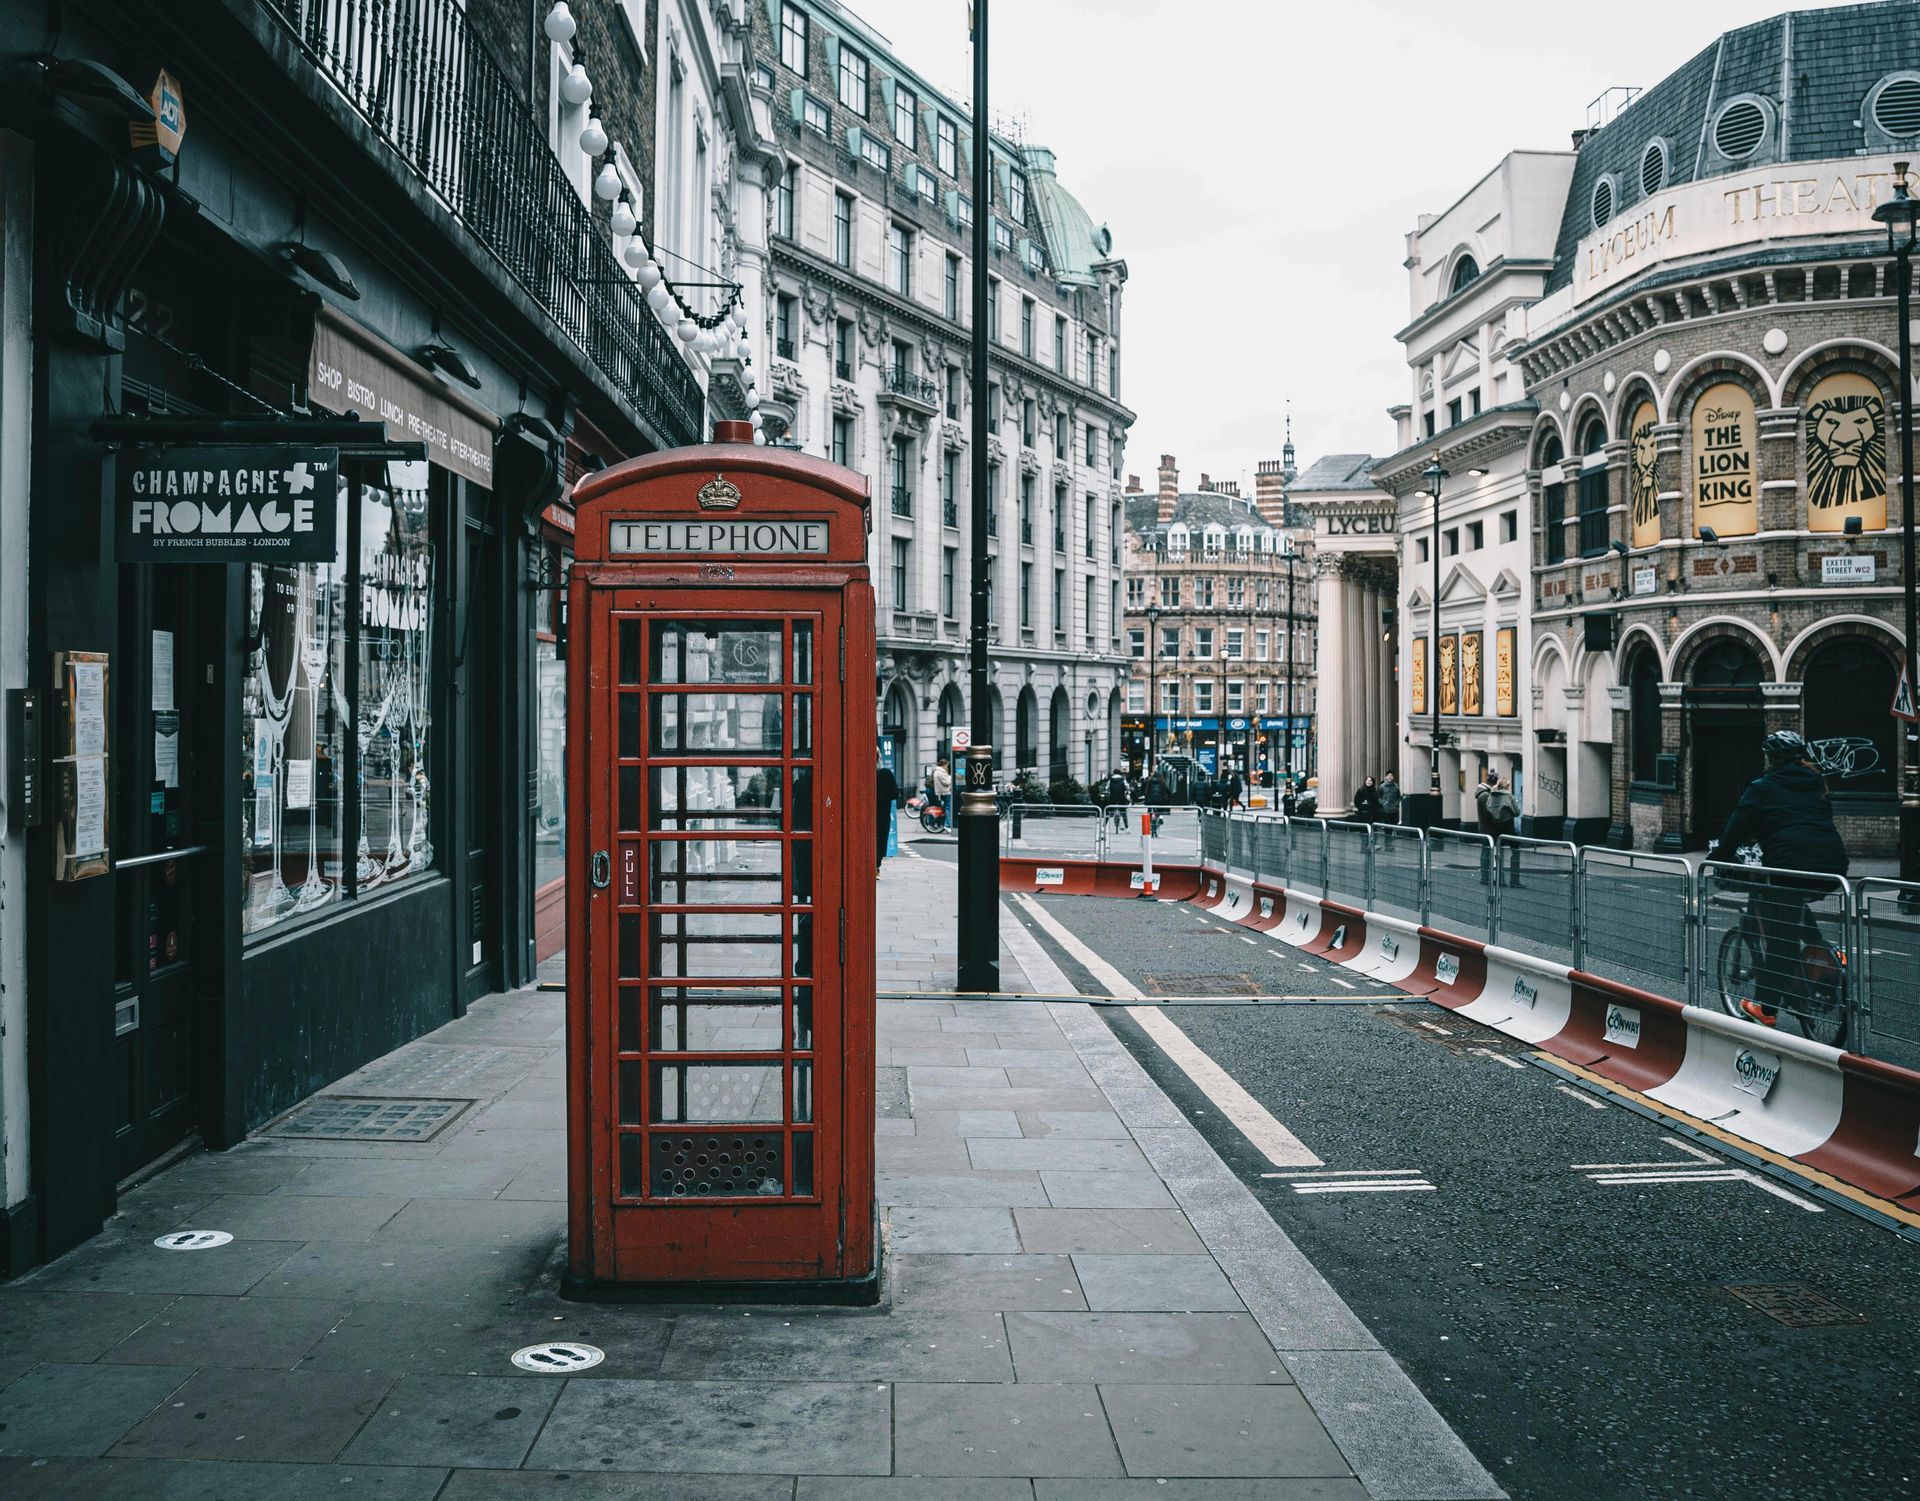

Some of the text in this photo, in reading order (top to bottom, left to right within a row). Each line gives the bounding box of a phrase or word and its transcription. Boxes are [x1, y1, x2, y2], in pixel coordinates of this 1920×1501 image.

[161, 101, 179, 127] ADT
[1589, 203, 1677, 281] LYCEUM
[318, 361, 491, 472] SHOP BISTRO LUNCH PRE-THEATRE AFTER-THEATRE
[1704, 424, 1742, 446] THE
[1699, 452, 1750, 475] LION
[132, 468, 280, 497] CHAMPAGNE
[1699, 480, 1752, 502] KING
[132, 500, 314, 534] FROMAGE
[1328, 513, 1399, 535] LYCEU
[153, 538, 165, 547] BY
[167, 538, 204, 547] FRENCH
[206, 538, 247, 547] BUBBLES
[253, 538, 291, 547] LONDON
[619, 524, 820, 551] TELEPHONE
[1825, 558, 1853, 567] EXETER
[1826, 565, 1872, 575] STREET WC2
[277, 582, 285, 594] TO
[362, 584, 428, 631] FROMAGE
[625, 849, 634, 897] PULL
[1607, 1008, 1640, 1035] CONWAY
